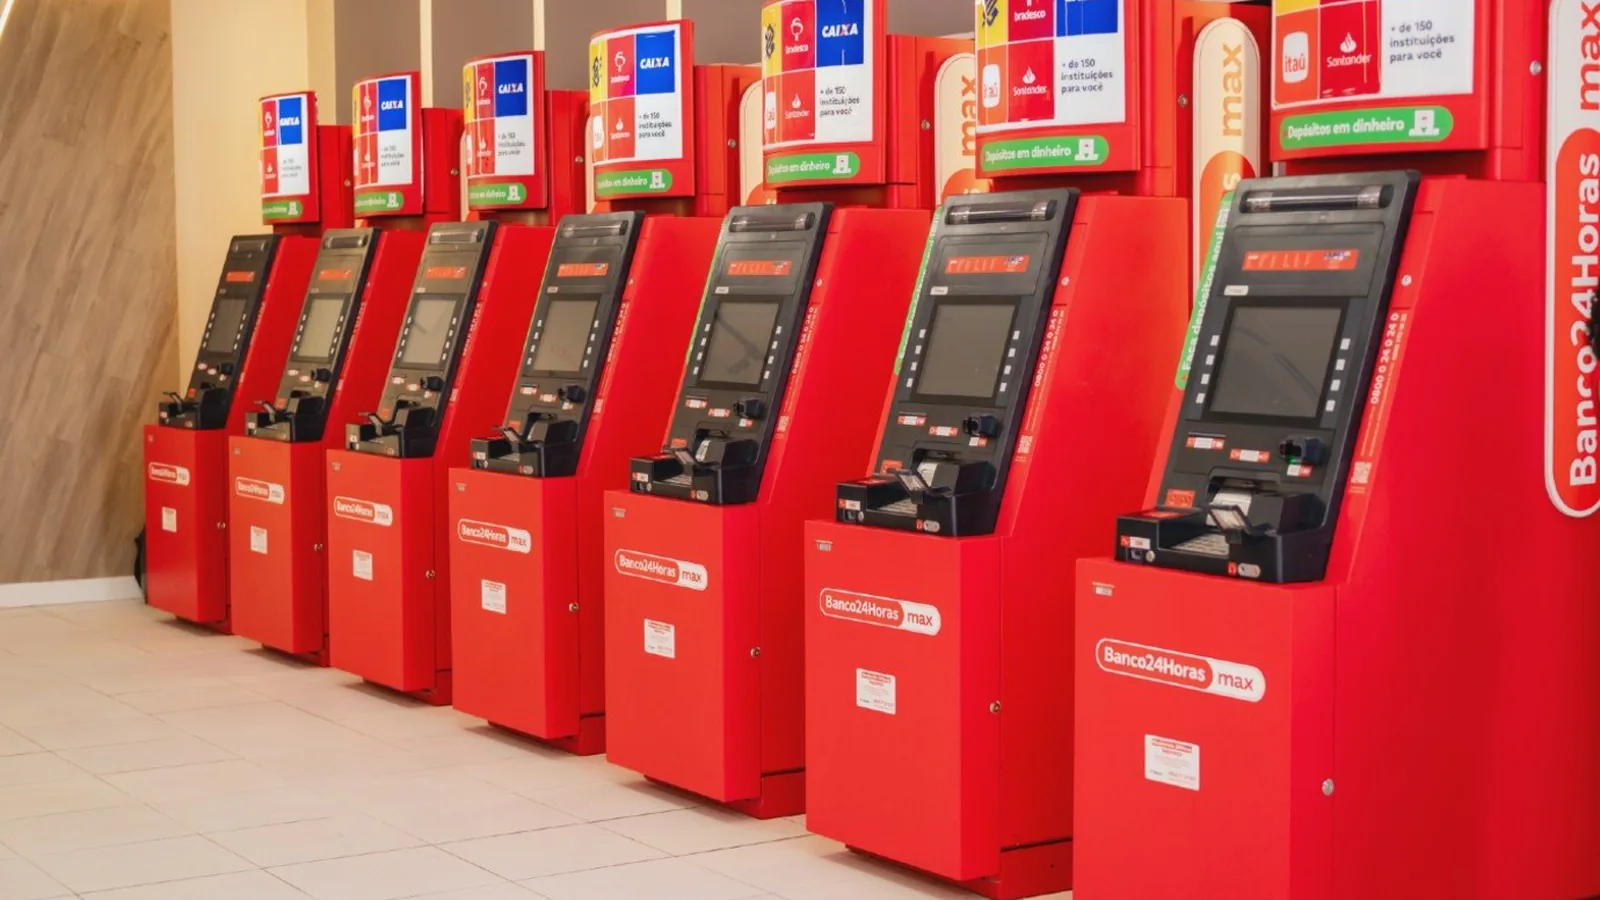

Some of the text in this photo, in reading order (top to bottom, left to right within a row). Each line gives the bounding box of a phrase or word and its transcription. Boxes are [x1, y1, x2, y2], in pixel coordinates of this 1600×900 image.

[1014, 9, 1046, 22] bradesco
[822, 23, 858, 38] CAIXA
[1399, 23, 1411, 33] de
[1415, 20, 1433, 31] 150
[1389, 34, 1455, 48] instituições
[640, 57, 669, 69] CAIXA
[1068, 59, 1079, 69] de
[1081, 58, 1096, 68] 150
[1284, 53, 1306, 73] itaú
[1327, 53, 1372, 68] Santander
[1389, 49, 1442, 64] para você
[1061, 70, 1113, 82] instituições
[499, 83, 523, 94] CAIXA
[1013, 85, 1047, 97] Santander
[1061, 85, 1080, 95] para
[1223, 44, 1242, 137] max
[1287, 117, 1405, 140] Depósitos em dinheiro
[1018, 149, 1030, 159] em
[1031, 144, 1071, 158] dinheiro
[800, 159, 829, 172] dinheiro
[619, 554, 702, 583] Banco24Horas max
[825, 595, 933, 627] Banco24Horas max
[1104, 646, 1253, 691] Banco24Horas max
